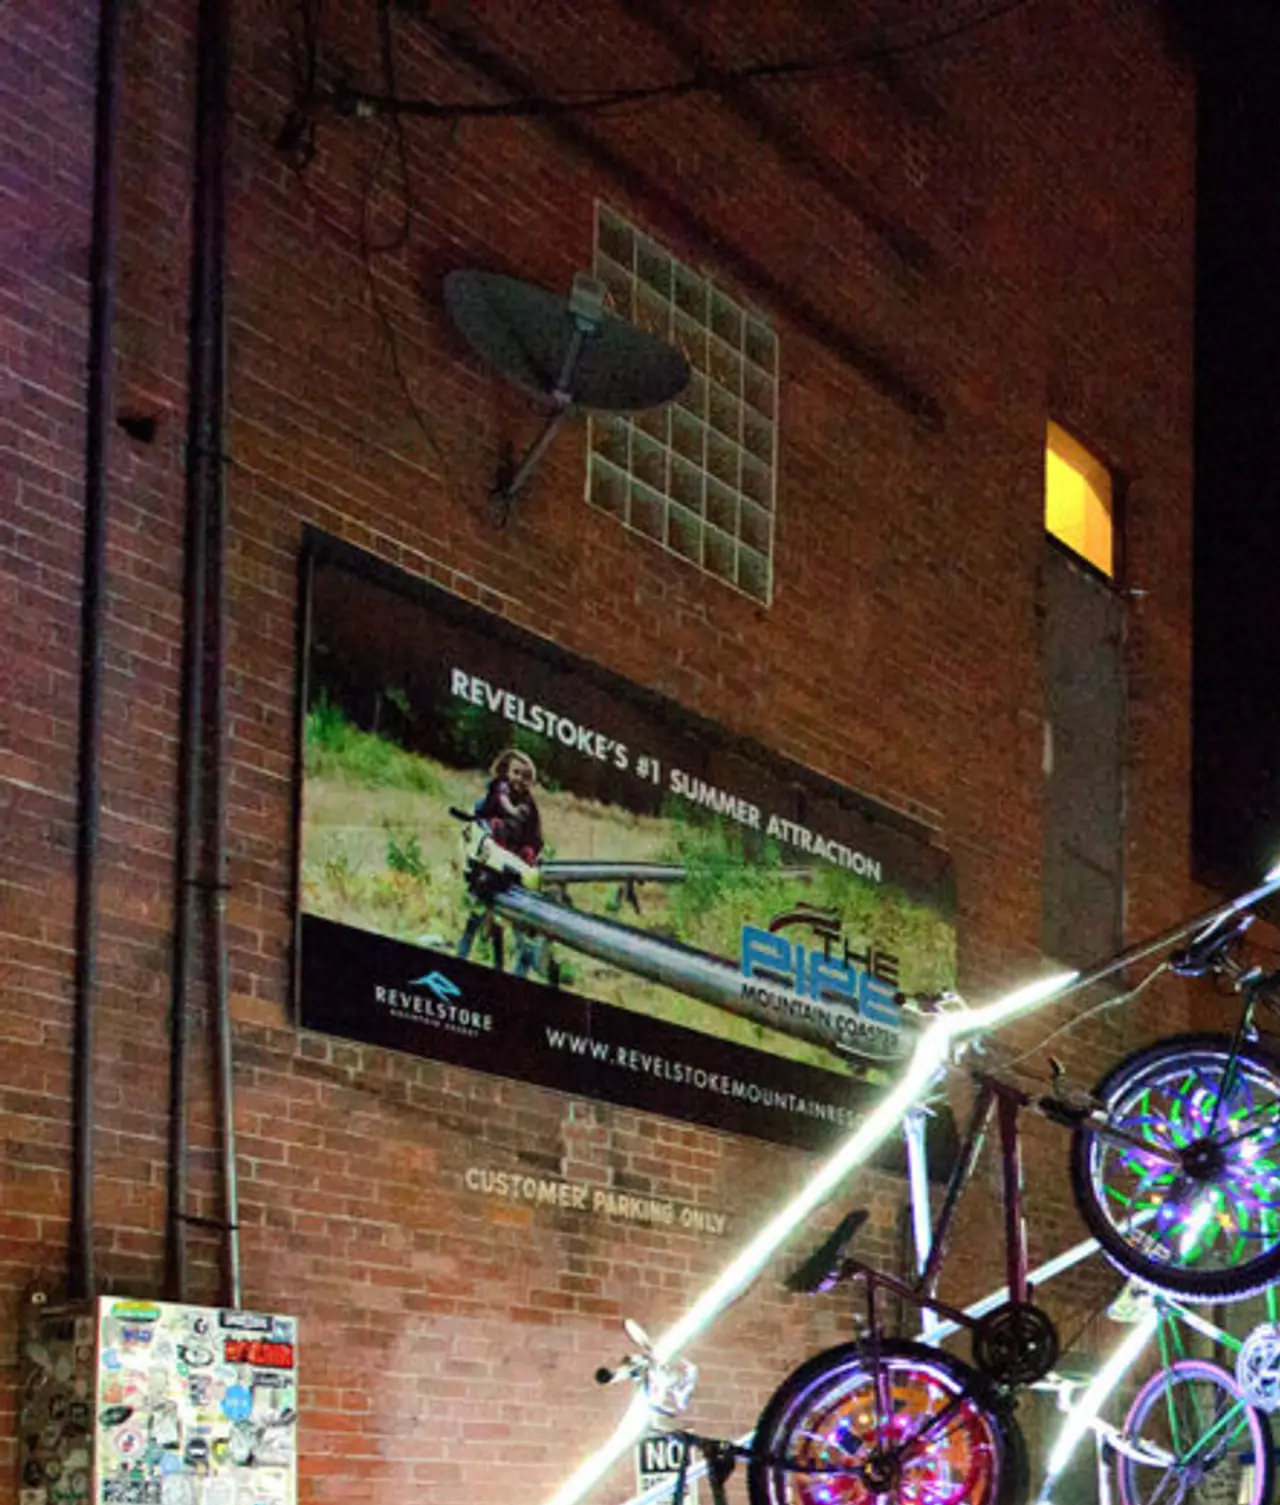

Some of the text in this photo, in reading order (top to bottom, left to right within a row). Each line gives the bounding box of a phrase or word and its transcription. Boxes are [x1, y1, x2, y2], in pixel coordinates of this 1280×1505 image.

[451, 667, 882, 883] REVELSTOKE'S #1 SUMMER ATTRACTION
[741, 924, 900, 1028] PIPE
[813, 925, 898, 987] THE
[741, 983, 831, 1027] MOUNTAIN
[465, 1167, 726, 1235] CUSTOMER PARKING ONLY
[645, 1440, 684, 1470] NO
